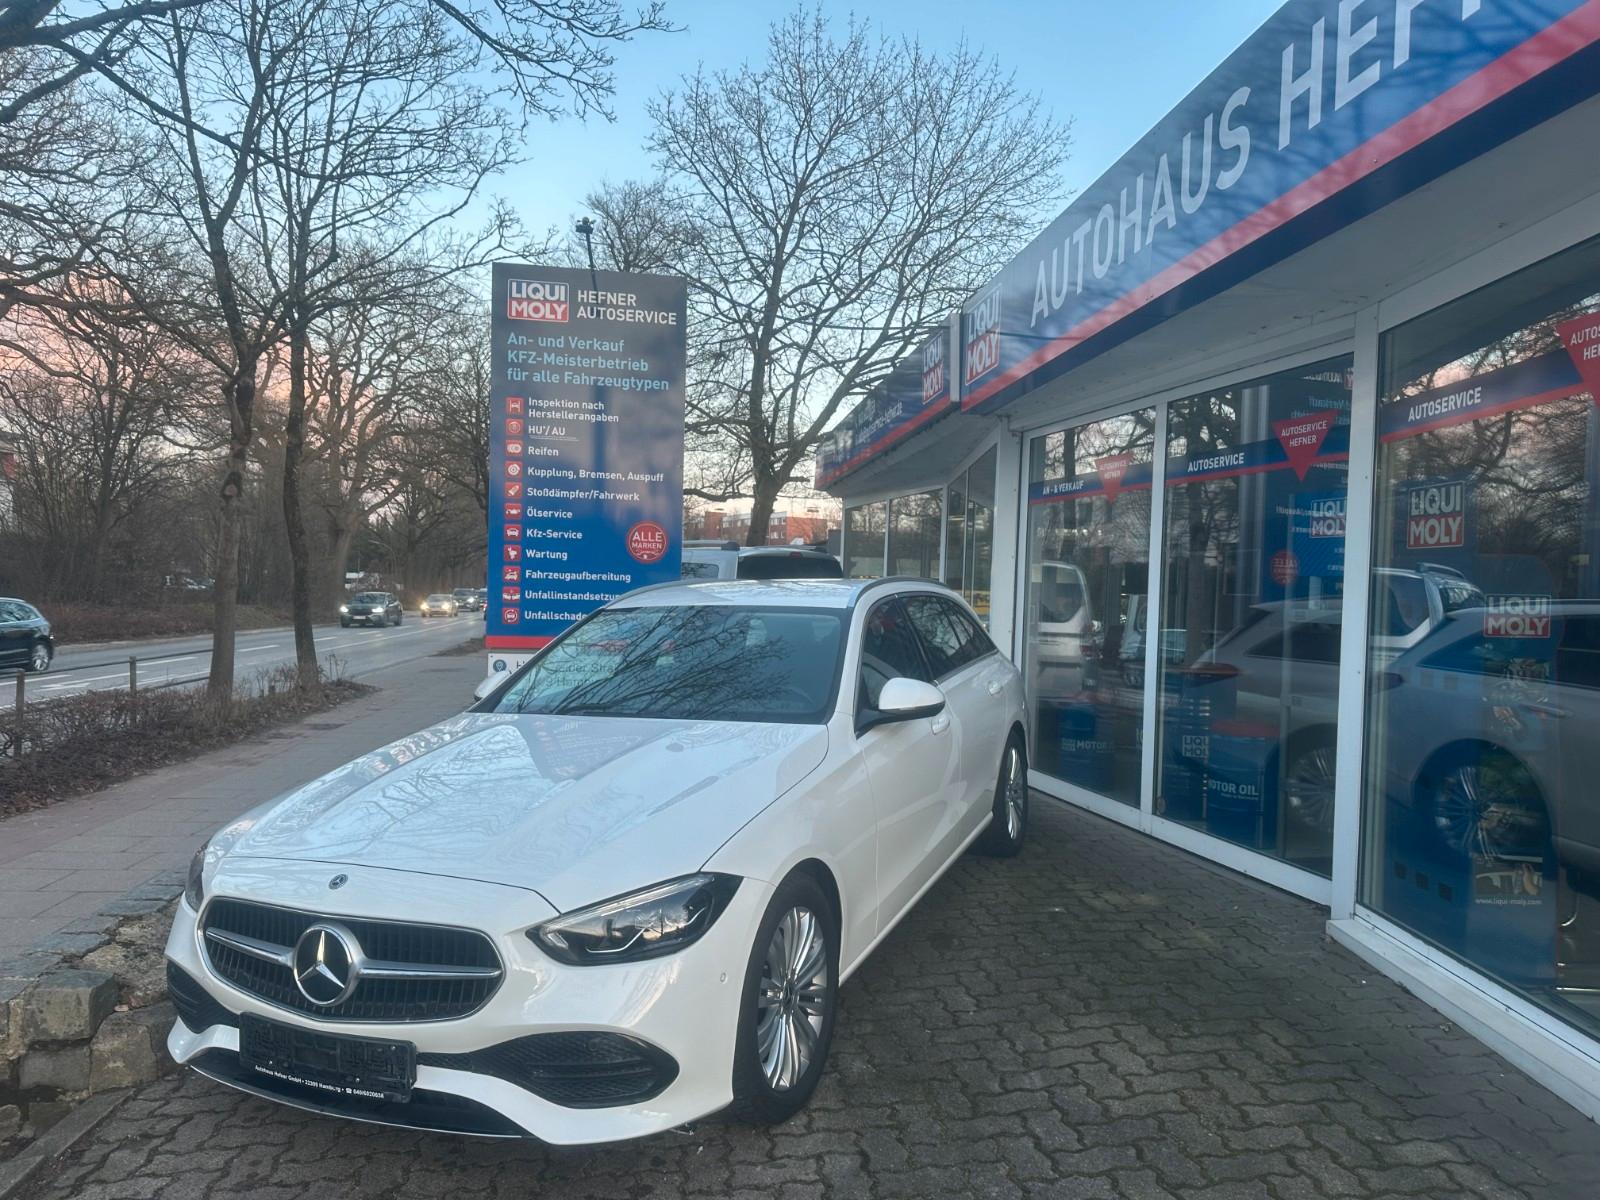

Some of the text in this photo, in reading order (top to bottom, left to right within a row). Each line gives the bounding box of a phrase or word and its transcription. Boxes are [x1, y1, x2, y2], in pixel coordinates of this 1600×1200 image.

[1030, 0, 1481, 328] AUTOHAUS HEF
[511, 282, 566, 301] LIQUI
[577, 290, 637, 306] HEFNER
[511, 301, 567, 320] MOLY
[577, 306, 677, 325] AUTOSERVICE
[968, 290, 1000, 344] LIQUI
[507, 332, 625, 352] An- und Verkauf
[507, 350, 649, 372] KFZ-Meisterbetrieb
[967, 333, 998, 380] MOLY
[507, 368, 669, 392] für alle Fahrzeugtypen
[528, 397, 605, 411] Inspektion nach
[1408, 387, 1482, 422] AUTOSERVICE
[528, 409, 619, 423] Herstellerangaben
[1281, 420, 1328, 437] AUTOSERVICE
[1289, 435, 1317, 447] HEFNER
[528, 446, 559, 457] Reifen
[1187, 453, 1245, 472] AUTOSERVICE
[527, 467, 664, 483] Kupplung, Bremsen, Auspuff
[1059, 480, 1085, 493] VERKAUF
[1410, 485, 1462, 516] LIQUI
[526, 507, 573, 519] Ölservice
[526, 529, 583, 540] Kfz-Service
[632, 531, 663, 542] ALLE
[1410, 516, 1463, 545] MOLY
[526, 549, 568, 561] Wartung
[525, 570, 631, 583] Fahrzeugaufbereitung
[1488, 597, 1548, 615] LIQUI
[1487, 616, 1550, 635] MOLY
[1239, 784, 1260, 796] OIL
